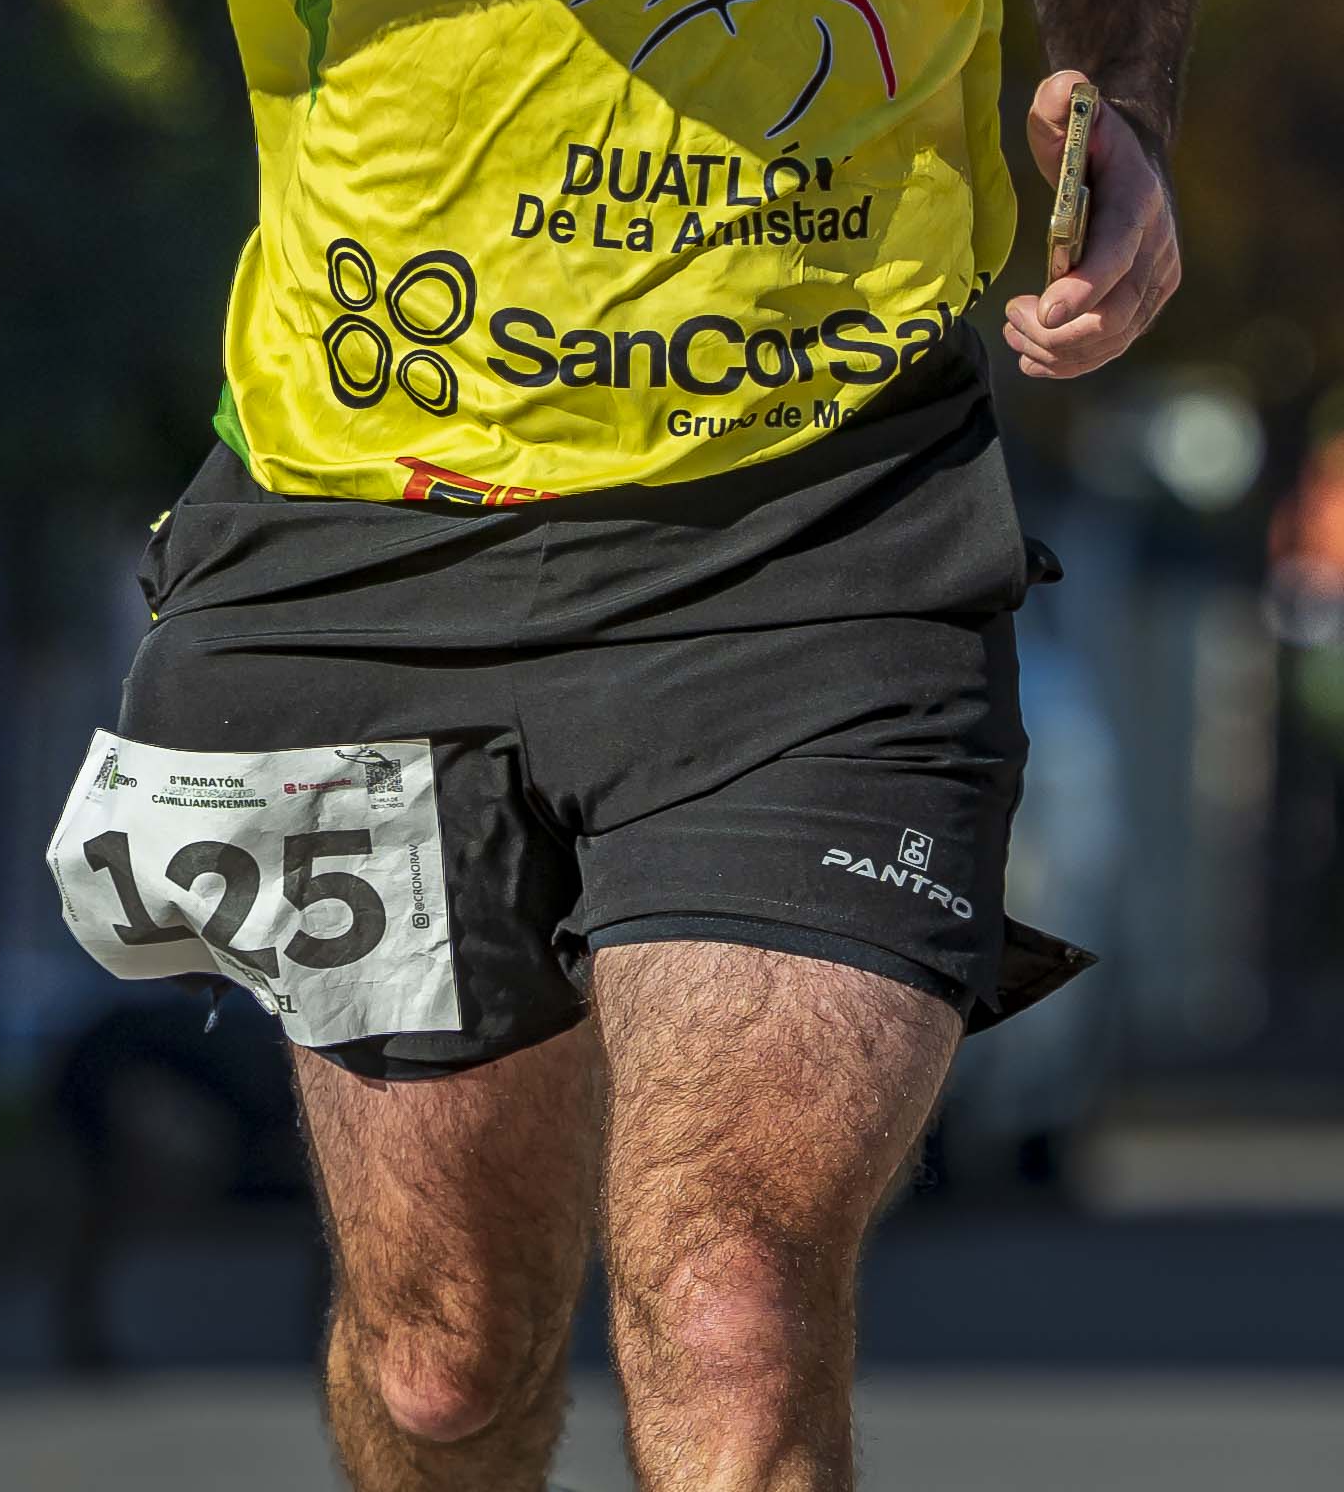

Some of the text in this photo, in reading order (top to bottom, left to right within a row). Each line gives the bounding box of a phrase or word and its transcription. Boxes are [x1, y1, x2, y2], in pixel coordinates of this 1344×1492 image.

[512, 194, 874, 254] De La Amistad
[487, 268, 993, 396] SanCorSa
[765, 401, 802, 428] de
[83, 829, 387, 979] 125
[408, 844, 428, 910] @CRONORAV
[821, 848, 973, 919] PANTRO
